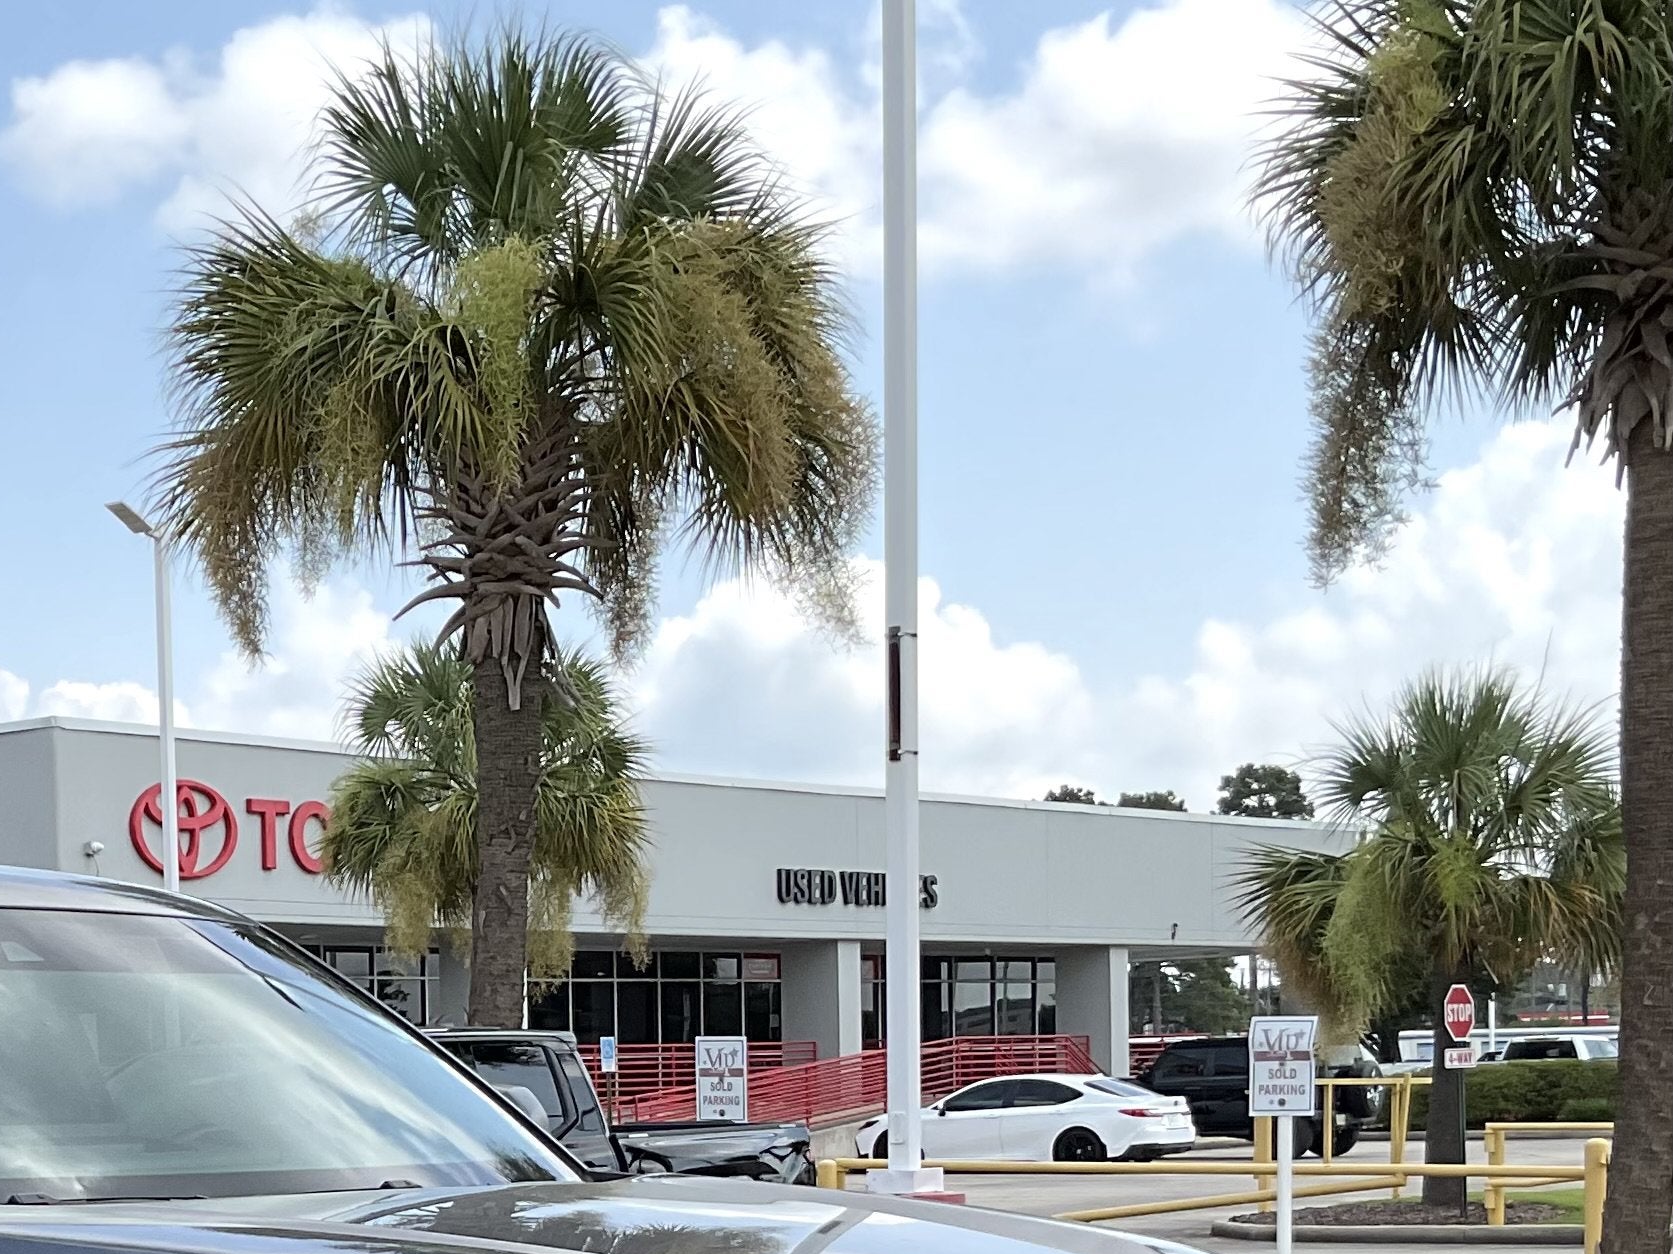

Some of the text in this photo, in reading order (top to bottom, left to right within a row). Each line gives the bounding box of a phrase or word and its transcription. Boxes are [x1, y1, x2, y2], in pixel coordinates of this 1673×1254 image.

[776, 868, 837, 905] USED
[1447, 1003, 1472, 1023] STOP
[1448, 1052, 1473, 1065] 4-WAY
[1267, 1068, 1297, 1080] SOLD
[710, 1081, 733, 1092] SOLD
[1258, 1084, 1306, 1096] PARKING
[702, 1095, 740, 1106] PARKING
